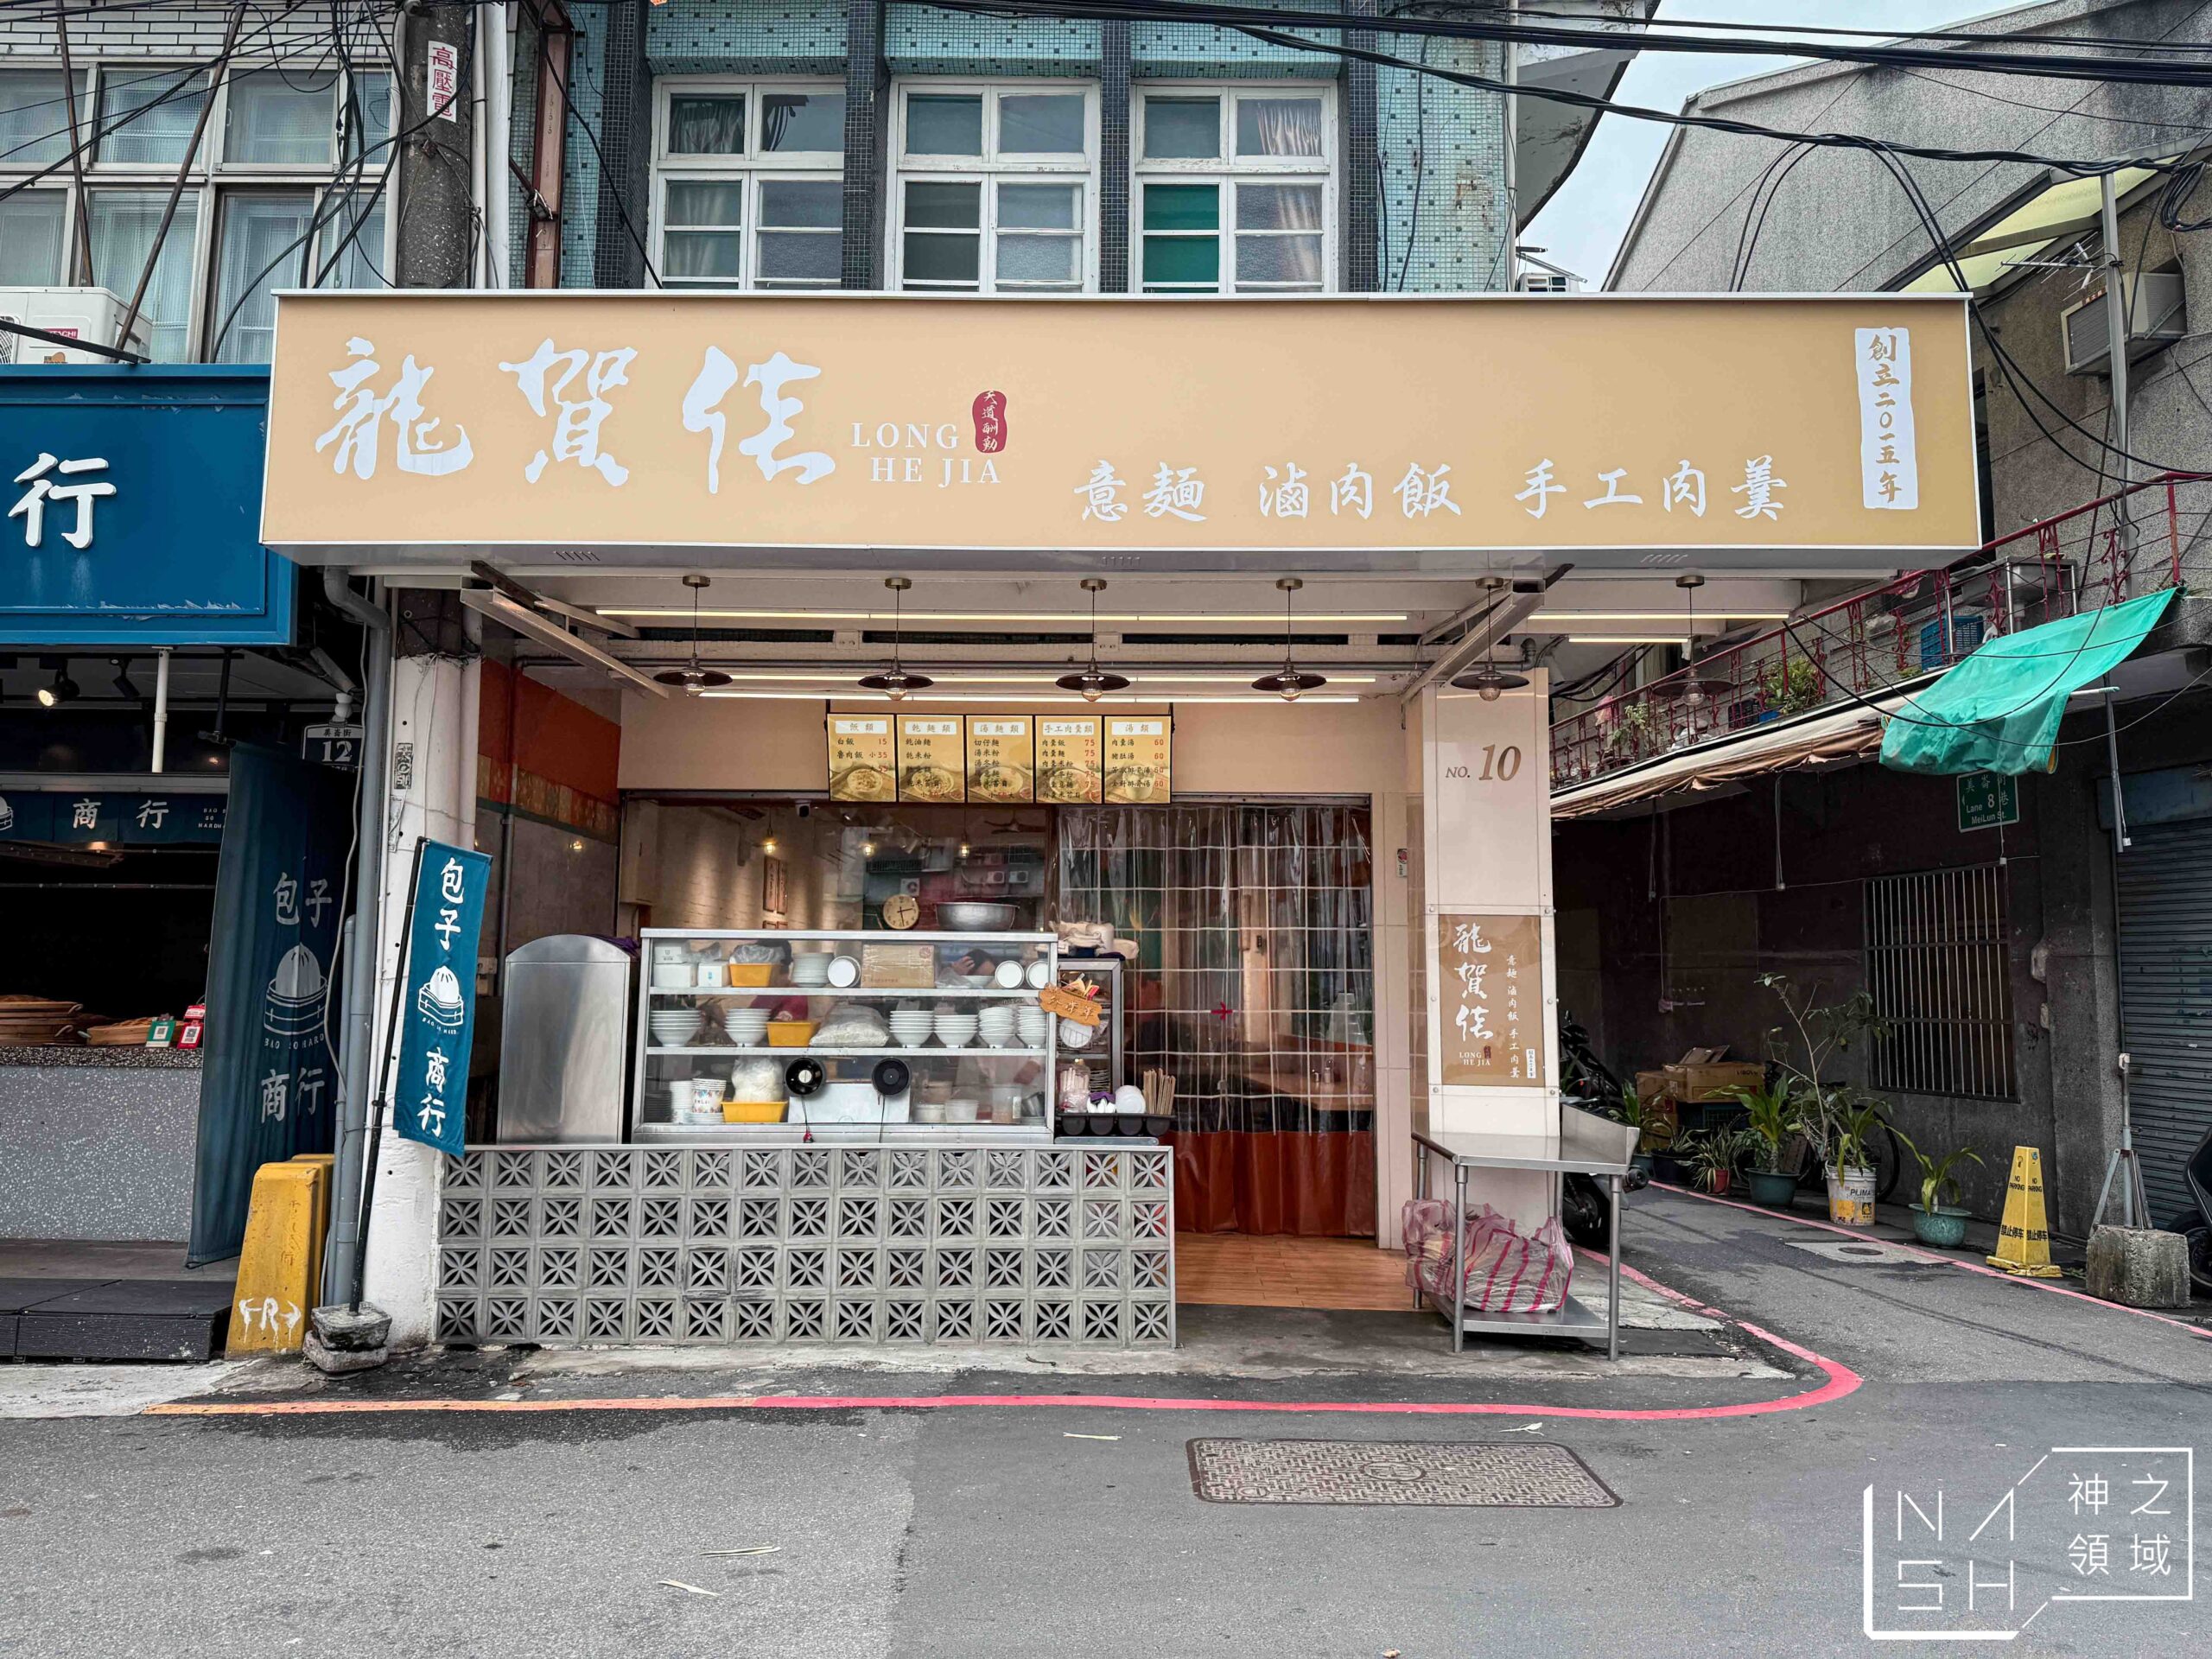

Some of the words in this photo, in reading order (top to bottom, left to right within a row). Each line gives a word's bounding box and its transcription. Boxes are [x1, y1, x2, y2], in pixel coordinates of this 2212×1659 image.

[432, 47, 454, 118] 高壓電
[315, 335, 836, 494] 龍賀佳
[851, 422, 958, 449] LONG
[870, 456, 923, 483] HE
[938, 457, 1001, 488] JIA
[1073, 459, 1207, 521] 意麵
[1258, 461, 1461, 519] 滷肉飯
[1514, 454, 1788, 521] 手工肉羹
[8, 452, 117, 549] 行
[321, 741, 353, 762] 12
[1446, 766, 1471, 779] NO.
[1478, 744, 1522, 781] 10
[73, 798, 169, 830] 商行
[1966, 804, 1983, 814] Lane
[1987, 793, 1995, 809] 8
[273, 872, 333, 929] 包子
[434, 857, 465, 951] 包子
[1452, 923, 1494, 1042] 龍賀佳
[302, 1033, 325, 1049] HARD
[1509, 1028, 1521, 1079] 手工肉羹
[261, 1069, 325, 1123] 商行
[416, 1046, 450, 1137] 商行
